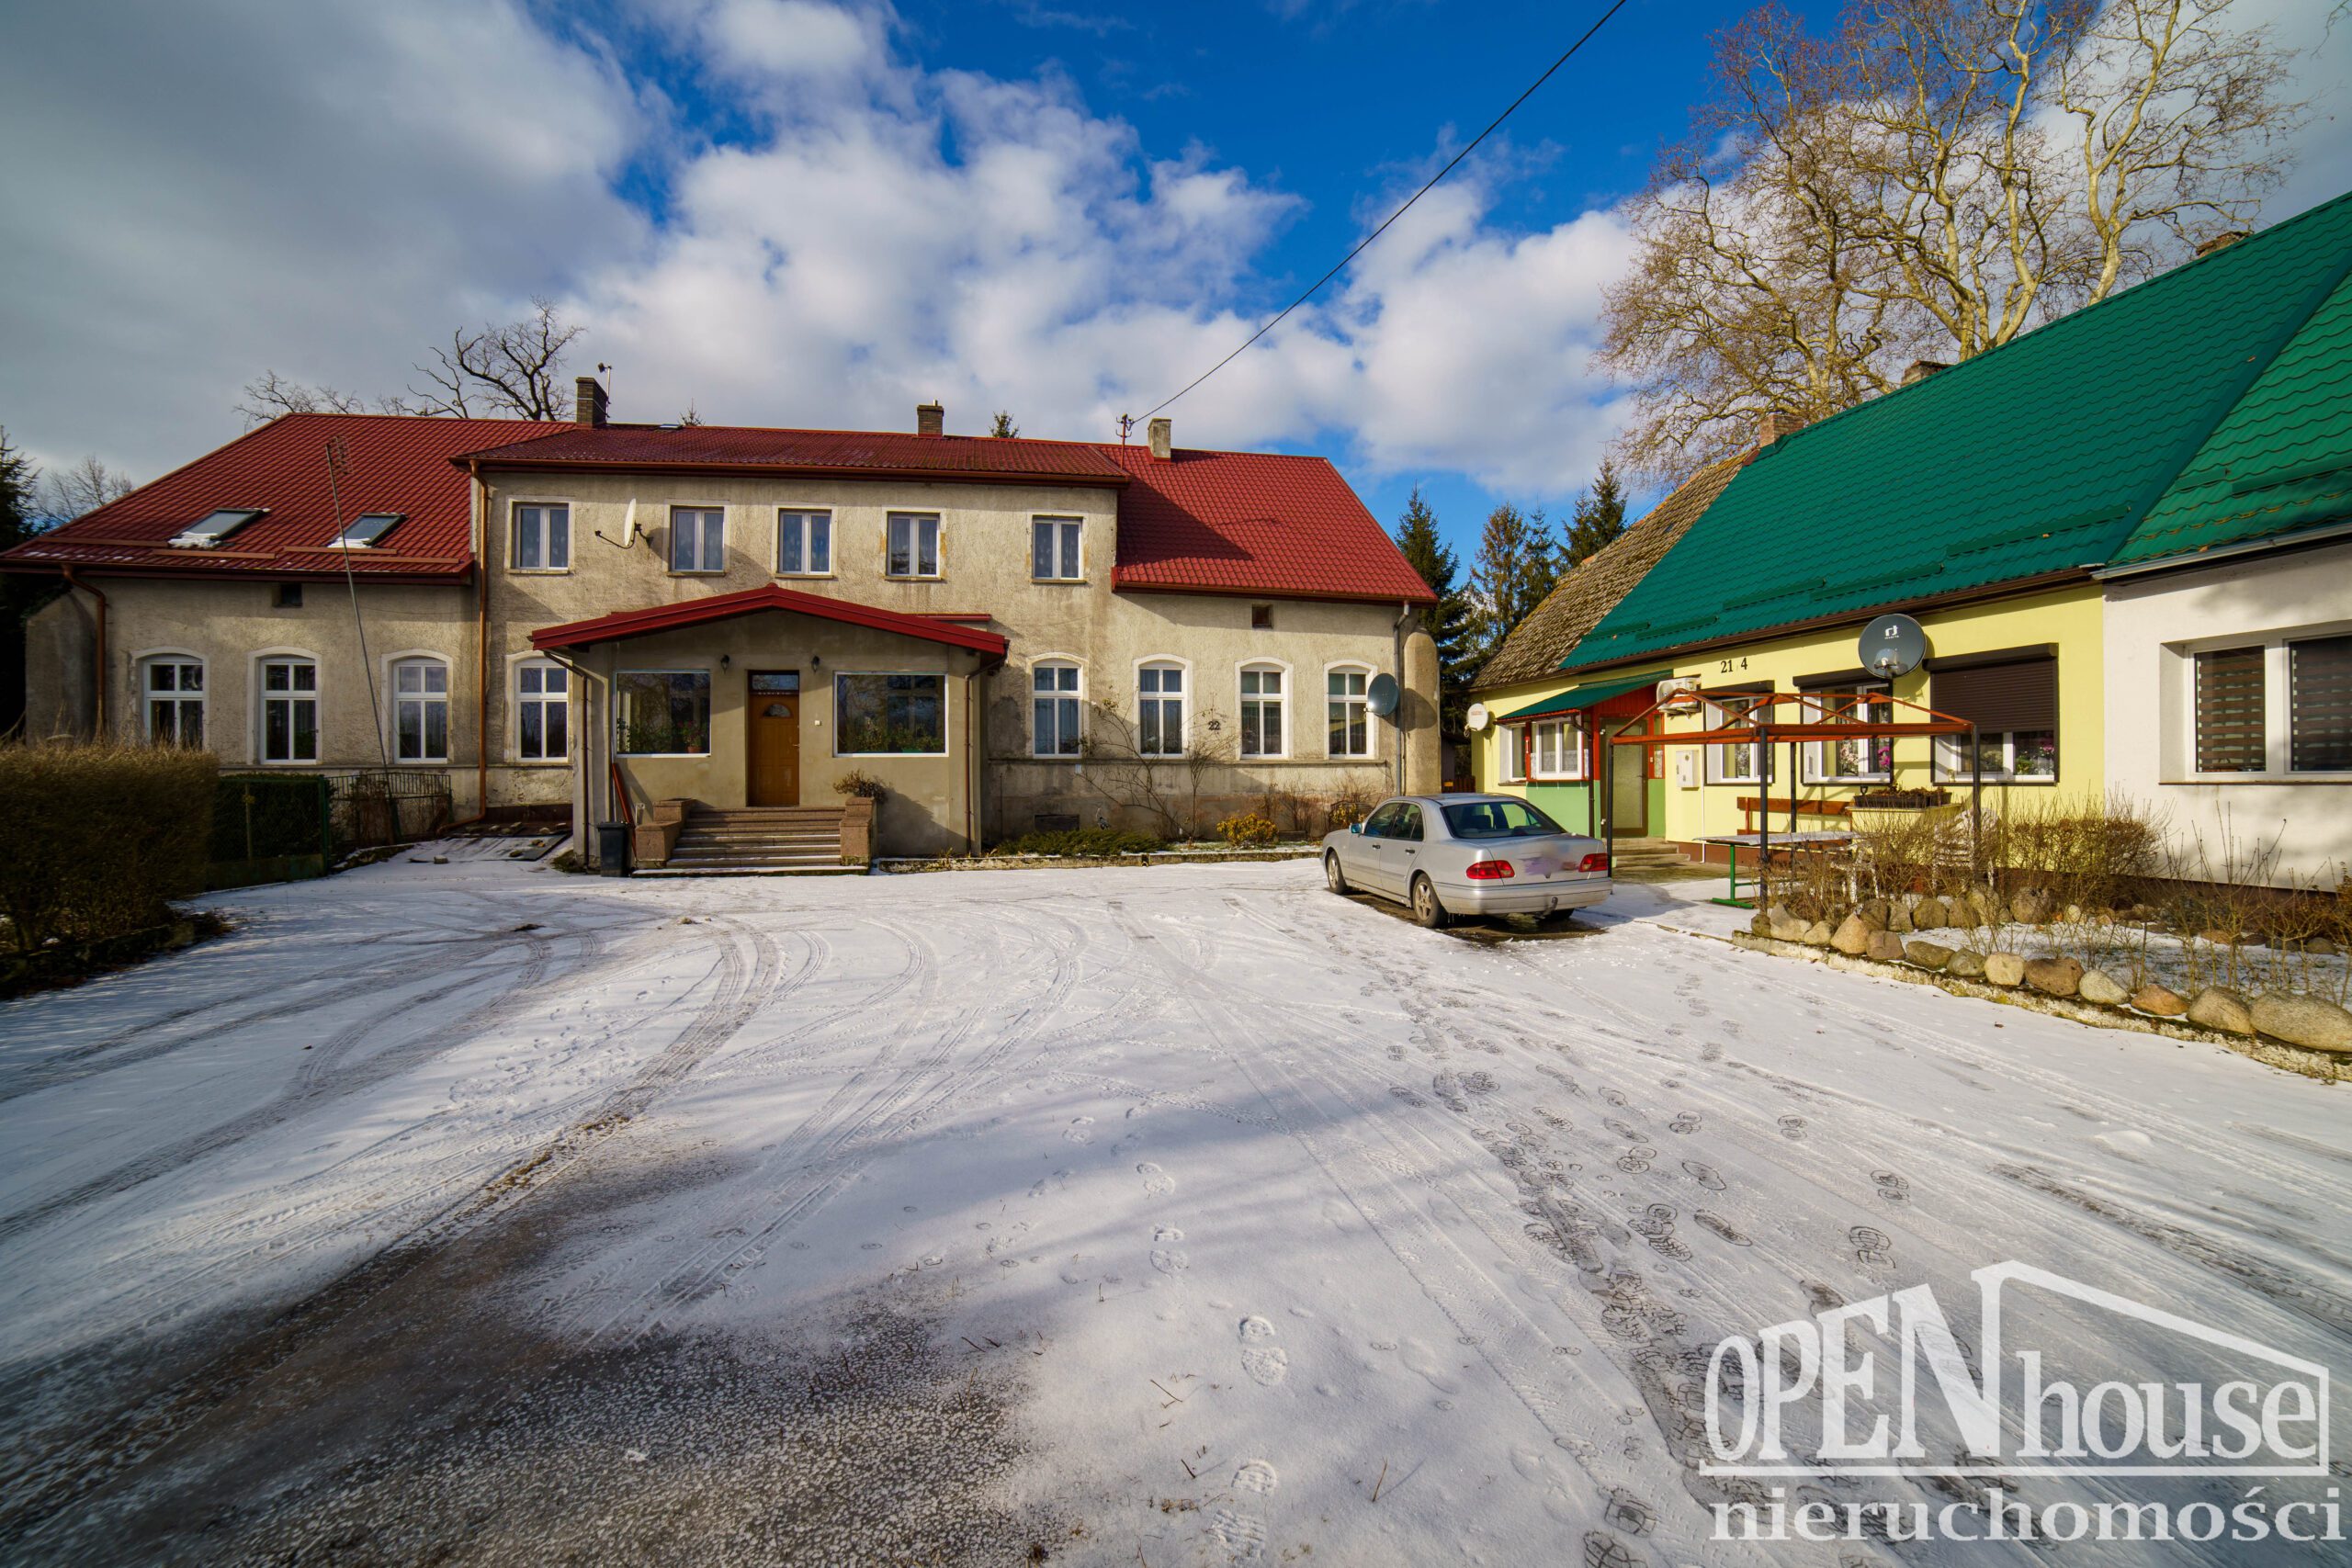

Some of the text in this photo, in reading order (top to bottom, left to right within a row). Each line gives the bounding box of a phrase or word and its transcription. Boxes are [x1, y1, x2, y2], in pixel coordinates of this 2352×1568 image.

[1721, 657, 1747, 673] 21 4
[1208, 720, 1221, 730] 22
